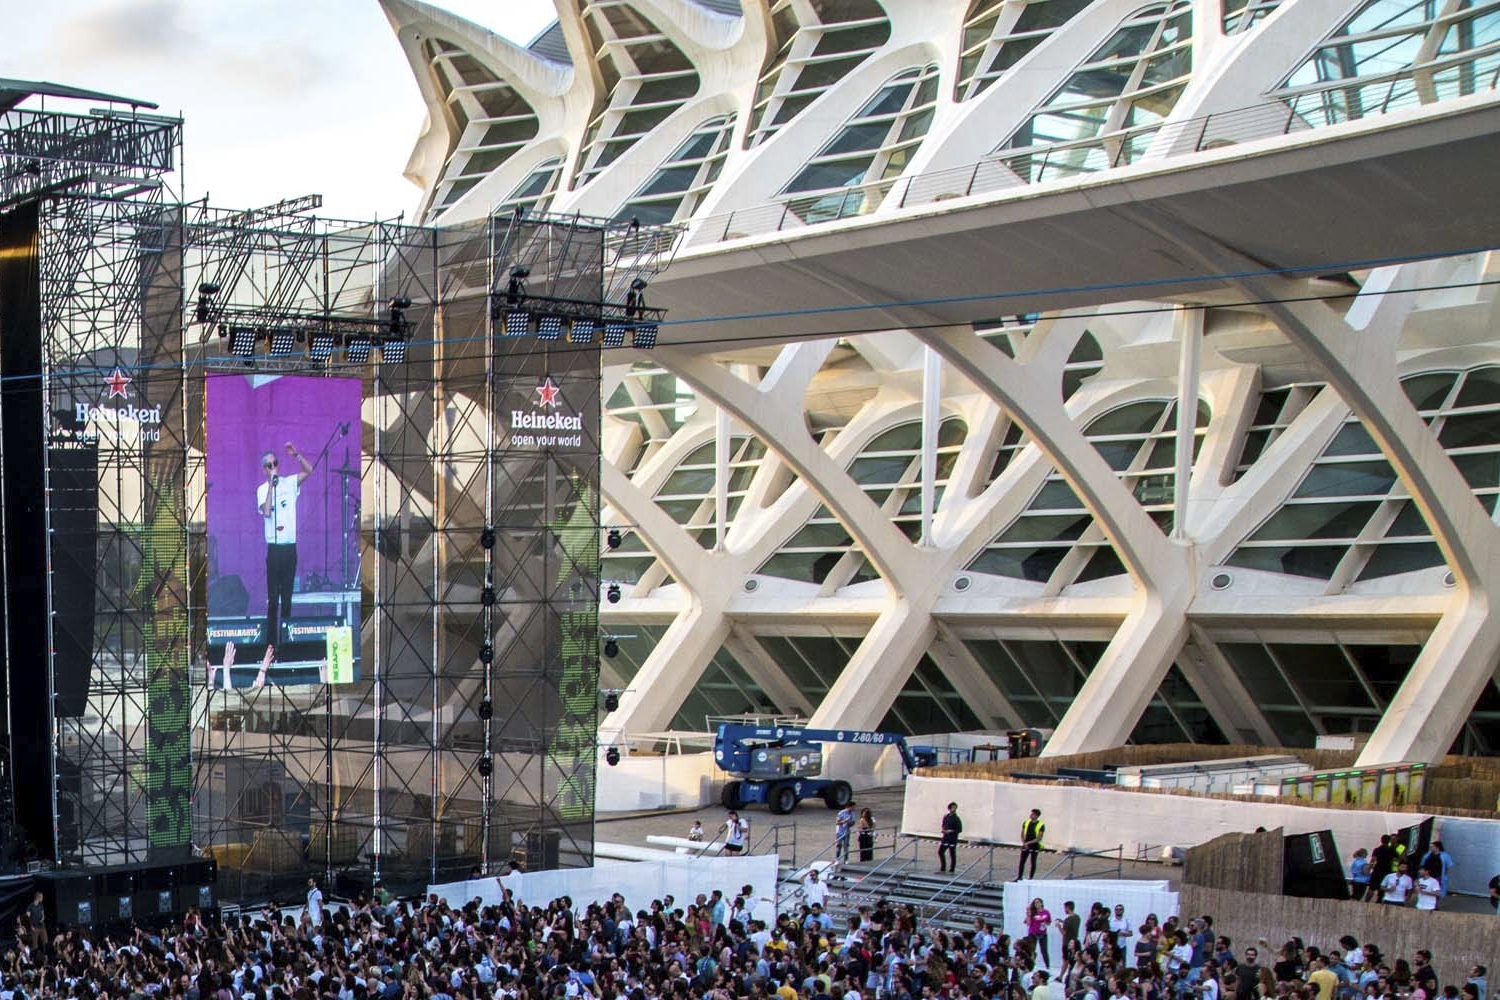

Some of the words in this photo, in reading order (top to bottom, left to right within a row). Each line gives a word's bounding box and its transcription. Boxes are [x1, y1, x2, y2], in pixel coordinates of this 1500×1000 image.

[511, 410, 582, 430] Heineken
[512, 435, 534, 446] open
[536, 435, 556, 447] your
[558, 435, 581, 446] world
